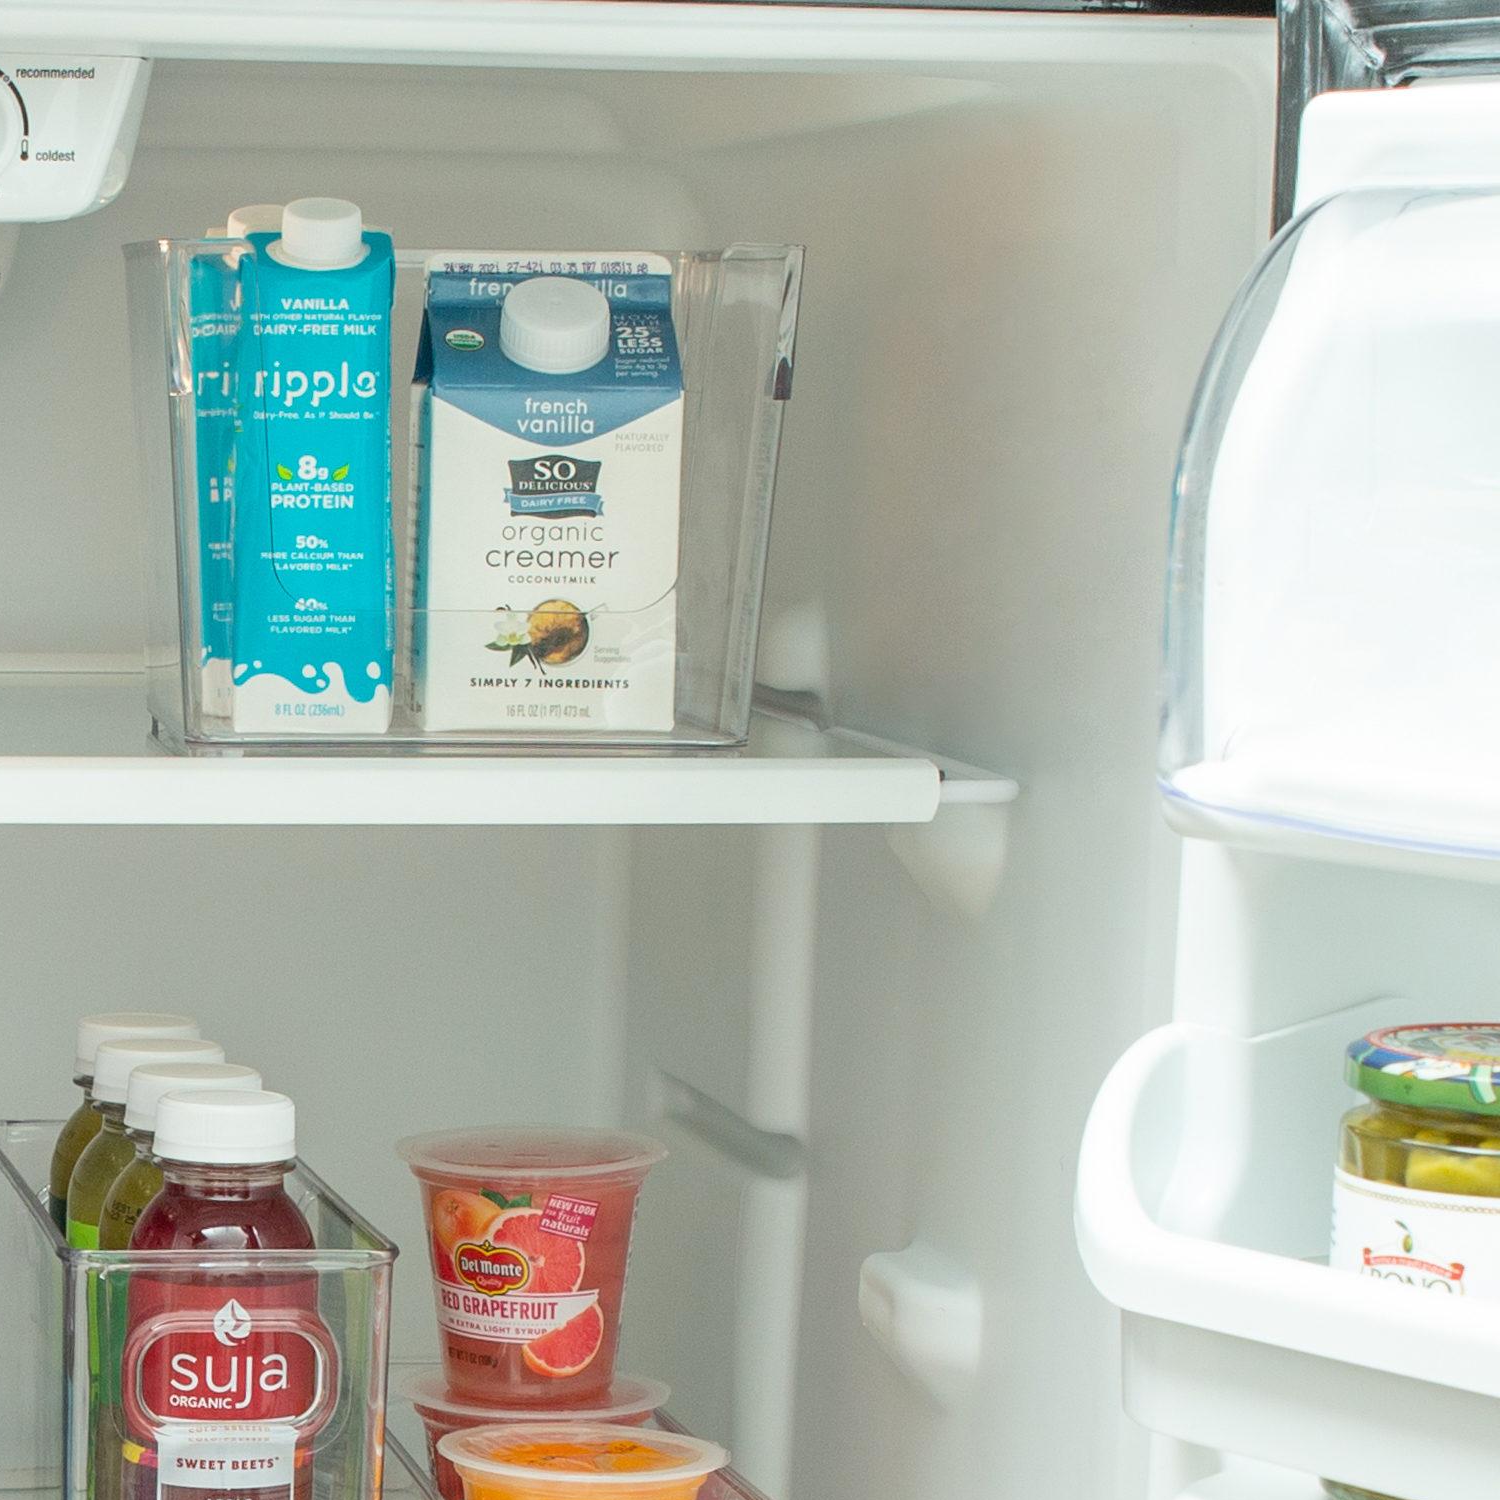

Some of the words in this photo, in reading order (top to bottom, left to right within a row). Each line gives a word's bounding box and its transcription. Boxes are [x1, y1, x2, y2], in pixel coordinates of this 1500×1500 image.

[16, 67, 95, 79] recommended
[35, 151, 75, 162] coldest
[469, 278, 513, 296] fren
[281, 298, 349, 310] VANILLA
[343, 323, 377, 336] MILK
[617, 338, 662, 348] LESS
[253, 360, 377, 407] ripple
[524, 397, 588, 414] french
[517, 413, 595, 434] vanilla
[614, 432, 670, 442] NATURALLY
[614, 443, 664, 452] FLAVORED
[297, 454, 329, 481] 8g
[534, 460, 576, 481] SO
[271, 482, 354, 493] PLANT-BASED
[519, 481, 589, 491] DELICIOUS
[270, 494, 354, 509] PROTEIN
[521, 498, 554, 508] DAIRY
[557, 496, 586, 506] FREE
[502, 522, 604, 546] organic
[296, 535, 328, 550] 50%
[291, 551, 334, 560] CALCIUM
[338, 551, 364, 560] THAN
[485, 549, 620, 569] creamer
[508, 574, 597, 584] COCONUTMILK
[293, 614, 325, 623] SUGAR
[329, 614, 356, 623] THAN
[270, 625, 323, 634] FLAVORED
[470, 677, 518, 688] SIMPLY
[524, 678, 532, 688] 7
[538, 678, 630, 690] INGREDIENTS
[549, 1198, 573, 1212] NEW
[573, 1203, 597, 1217] LOOK
[541, 1218, 590, 1238] naturals
[461, 1256, 479, 1273] Del
[480, 1258, 523, 1277] Monte
[441, 1288, 460, 1311] RED
[463, 1298, 559, 1320] GRAPEFRUIT
[455, 1319, 481, 1331] EXTRA
[484, 1323, 511, 1334] LIGHT
[515, 1327, 548, 1337] SYRUP
[170, 1353, 288, 1410] suja
[169, 1394, 233, 1409] ORGANIC
[176, 1458, 226, 1471] SWEET
[231, 1458, 275, 1471] BEETS
